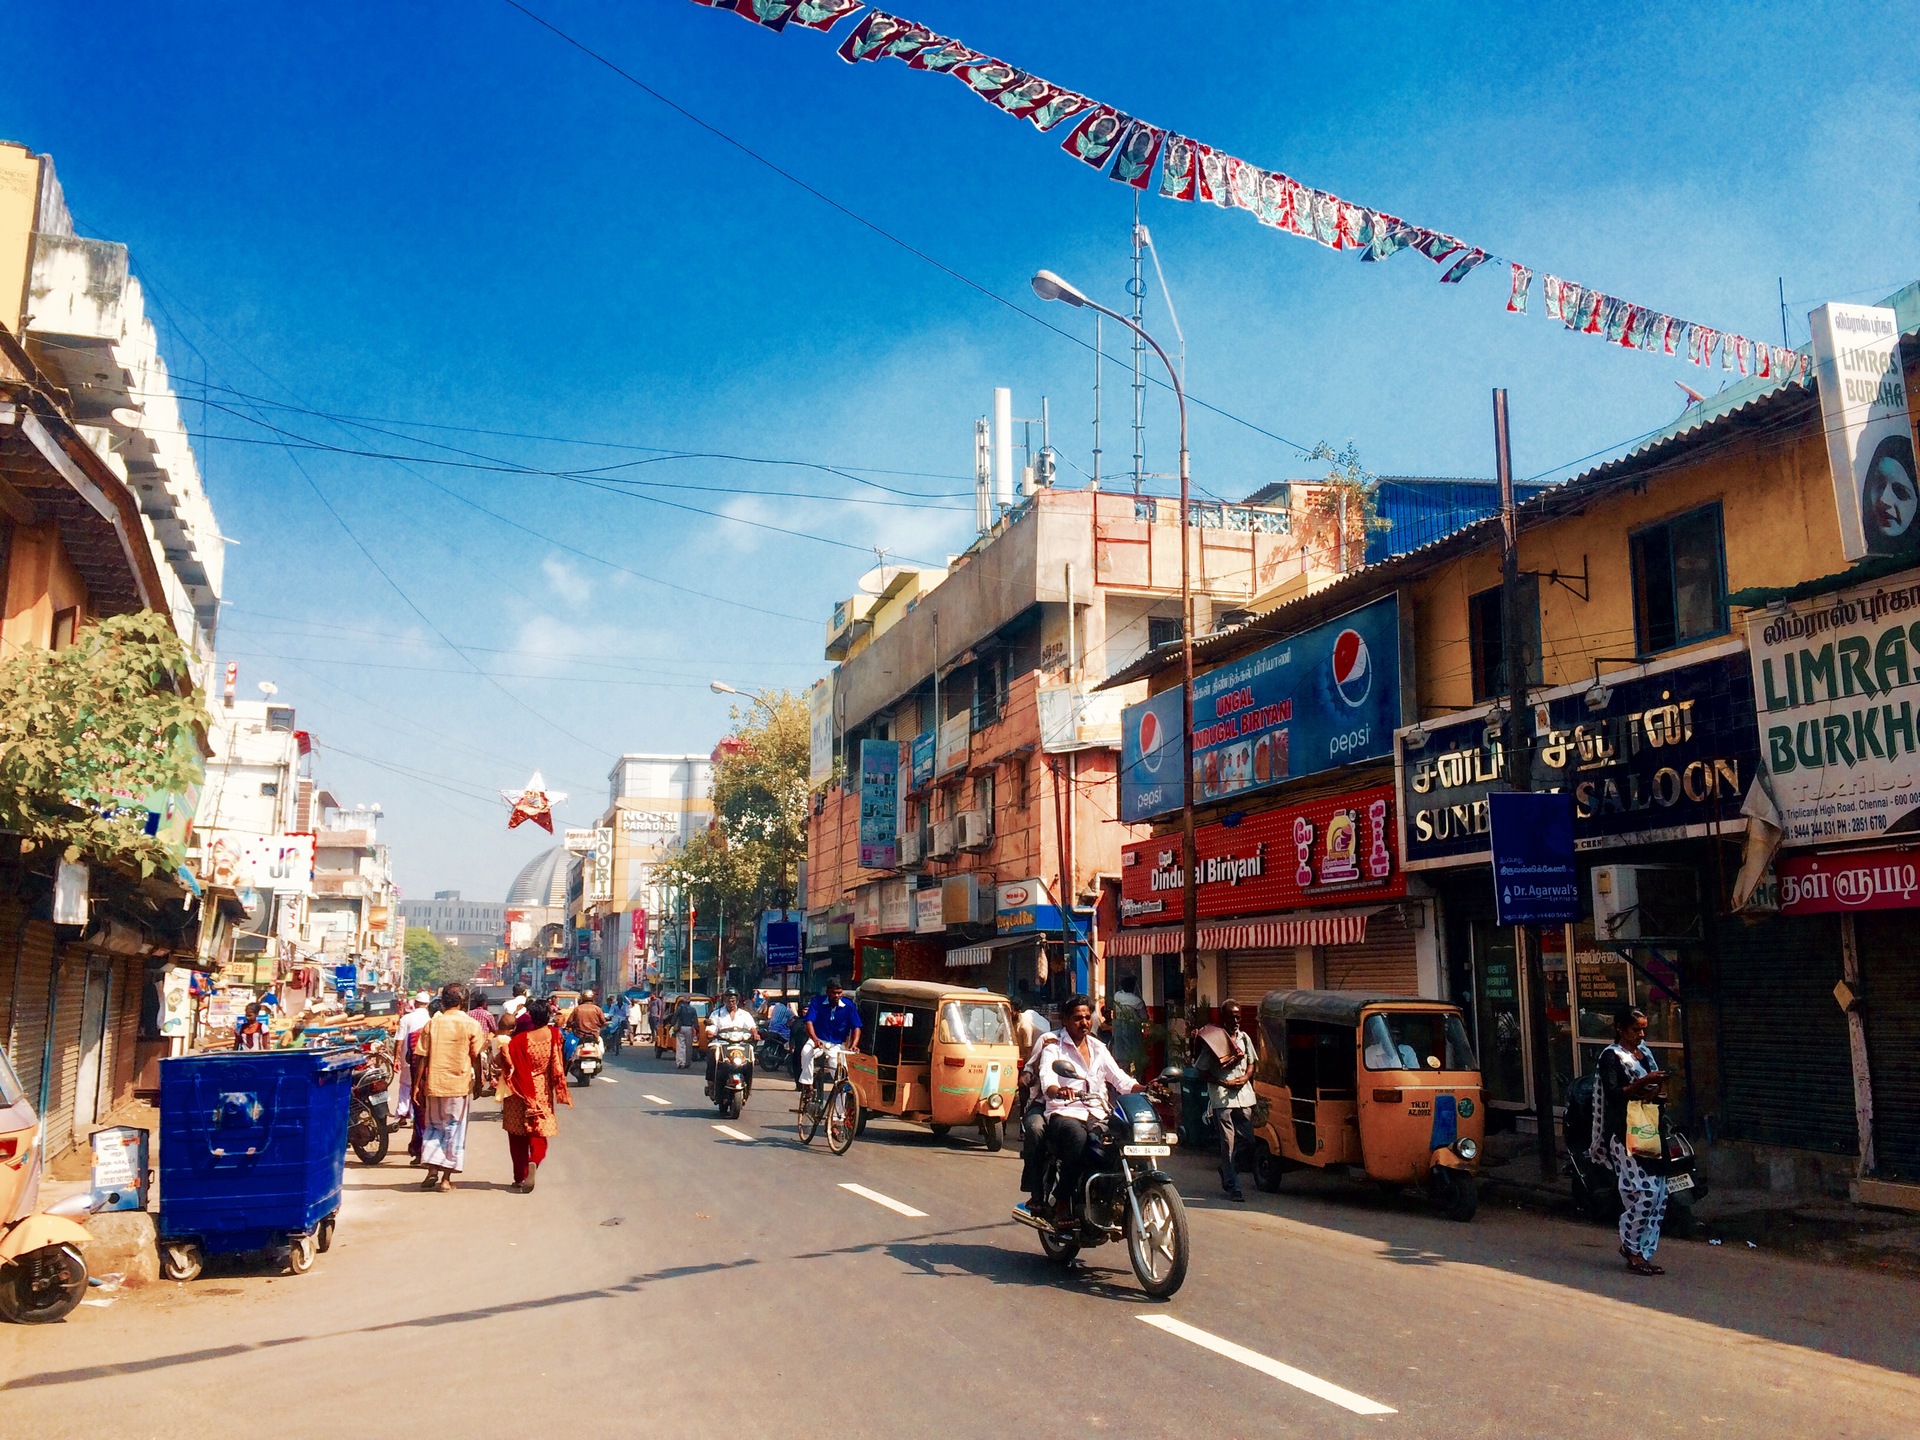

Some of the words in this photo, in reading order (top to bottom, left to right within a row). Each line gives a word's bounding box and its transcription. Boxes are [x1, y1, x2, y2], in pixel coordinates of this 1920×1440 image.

[1841, 346, 1899, 376] LIMRAS
[1844, 378, 1905, 407] BURKHA
[1215, 685, 1255, 717] UNGAL
[1192, 718, 1239, 752] INDUGAL
[1240, 698, 1293, 735] BIRIYANI
[1768, 700, 1920, 775] BURKH
[1330, 723, 1371, 760] pepsi
[1137, 786, 1162, 813] pepsi
[1576, 758, 1743, 819] SALOON
[623, 811, 679, 823] NOORI
[1786, 806, 1819, 820] Triplicane
[1837, 801, 1858, 813] Road,
[1859, 796, 1889, 810] Chennai
[1894, 794, 1908, 806] 600
[623, 821, 678, 832] PARADISE
[1794, 823, 1810, 839] 9444
[1824, 820, 1837, 836] 831
[1837, 818, 1847, 833] PH
[1852, 816, 1869, 833] 2851
[1869, 814, 1887, 830] 6780
[269, 847, 301, 880] JP
[596, 829, 612, 894] NOORI
[1150, 860, 1204, 892] Dindual
[1207, 850, 1261, 887] Biriyani
[1513, 884, 1528, 896] Dr.
[1528, 883, 1578, 898] Agarwal's
[1781, 862, 1919, 911] தள்ளுபடி
